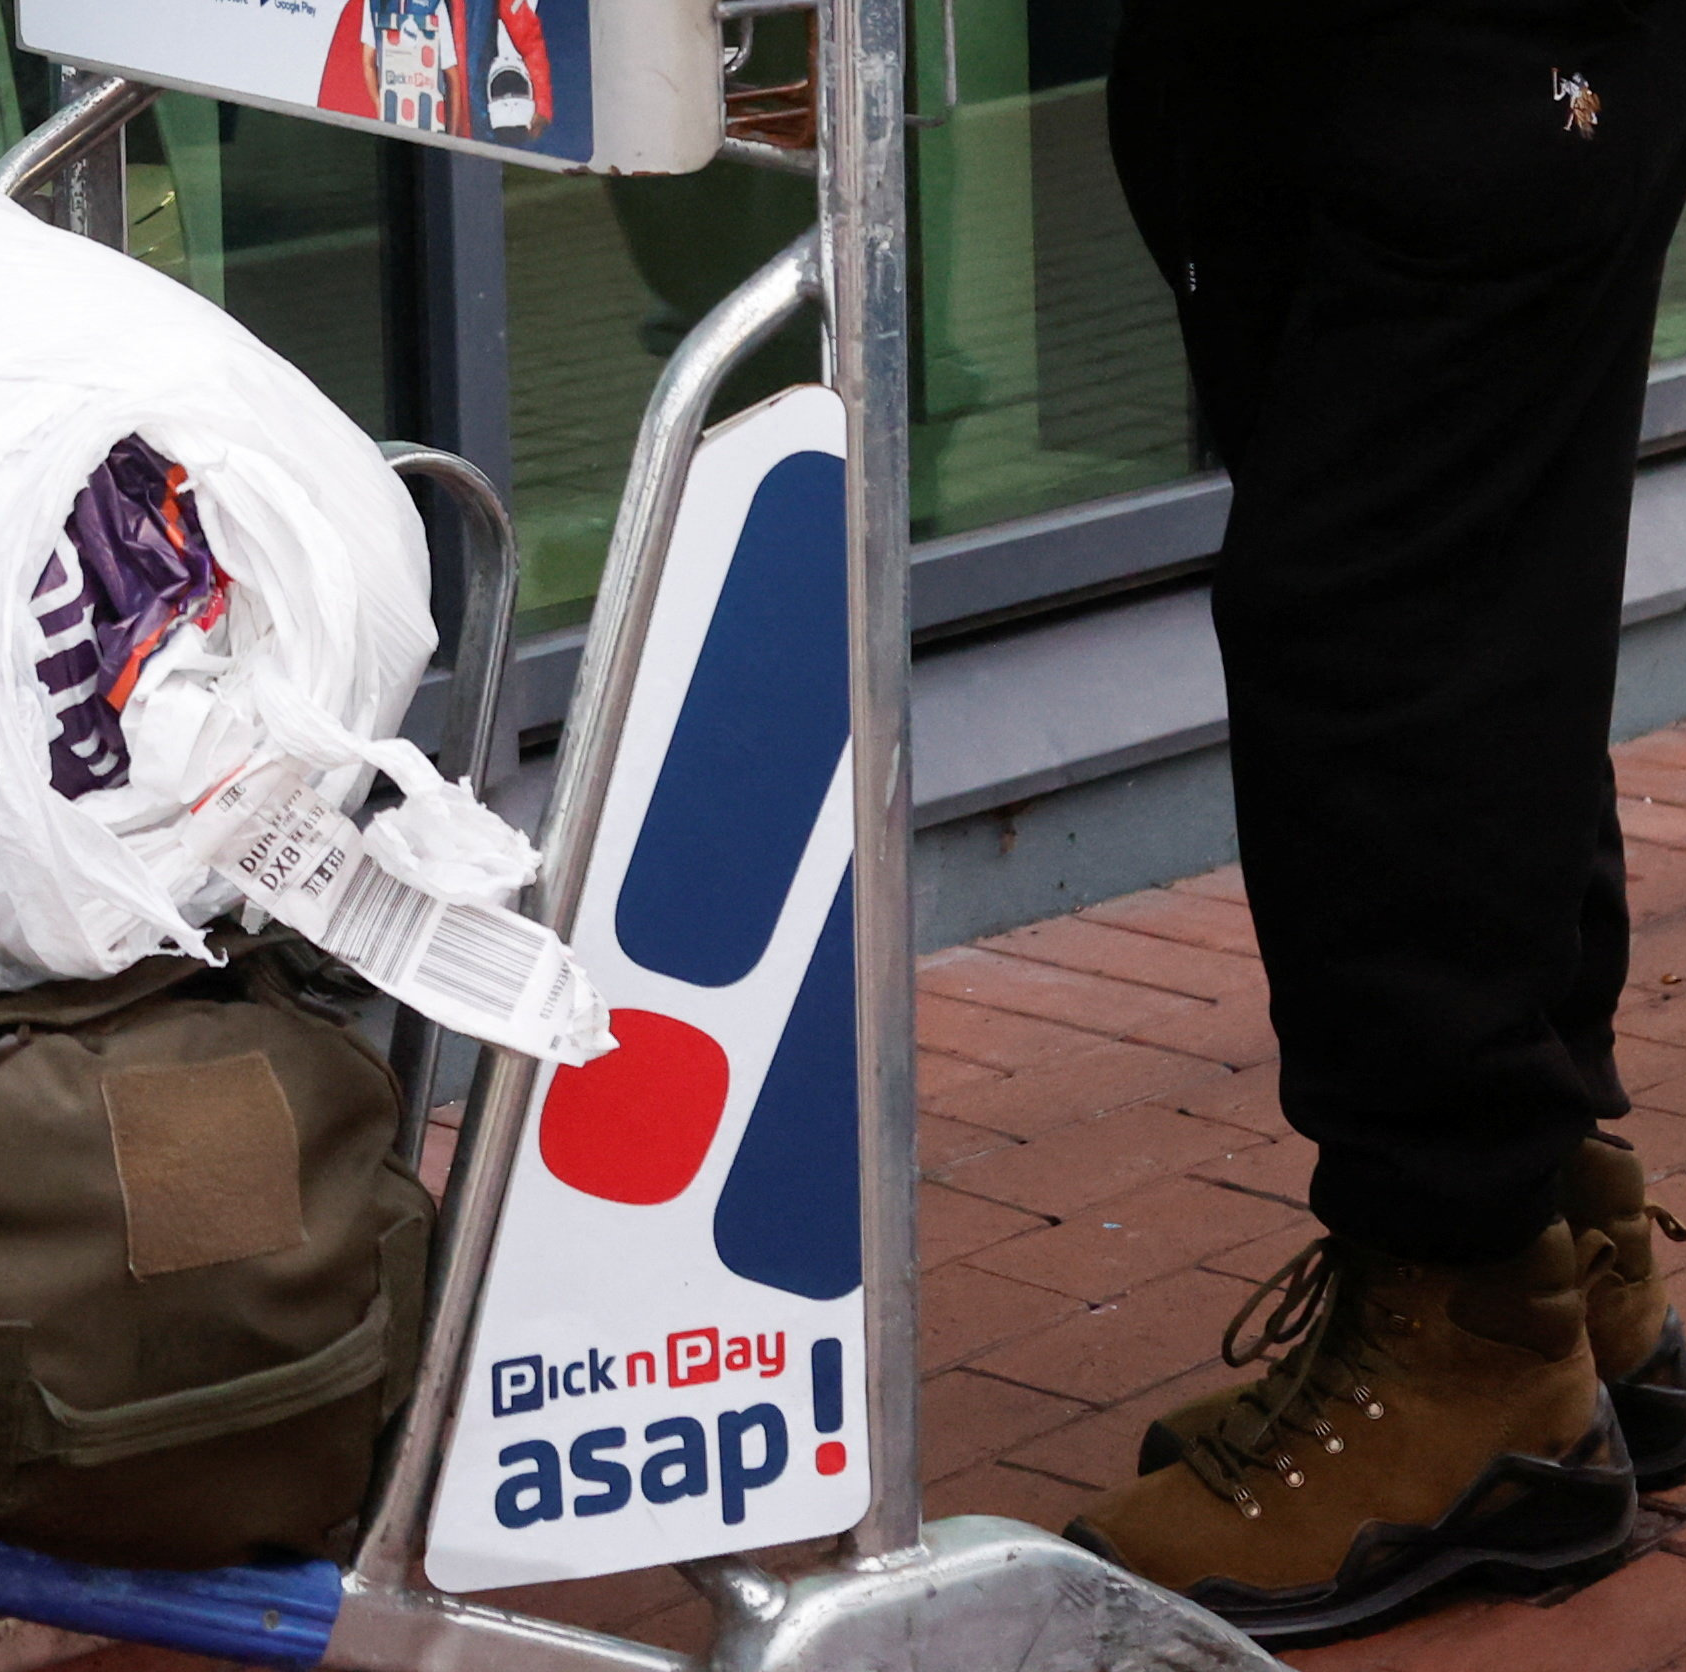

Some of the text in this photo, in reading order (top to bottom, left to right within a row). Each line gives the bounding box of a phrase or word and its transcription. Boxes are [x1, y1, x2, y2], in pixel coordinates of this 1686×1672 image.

[302, 1, 316, 17] Play
[260, 846, 301, 891] DXB
[491, 1326, 785, 1418] Pick n Pay
[494, 1337, 847, 1530] asap!
